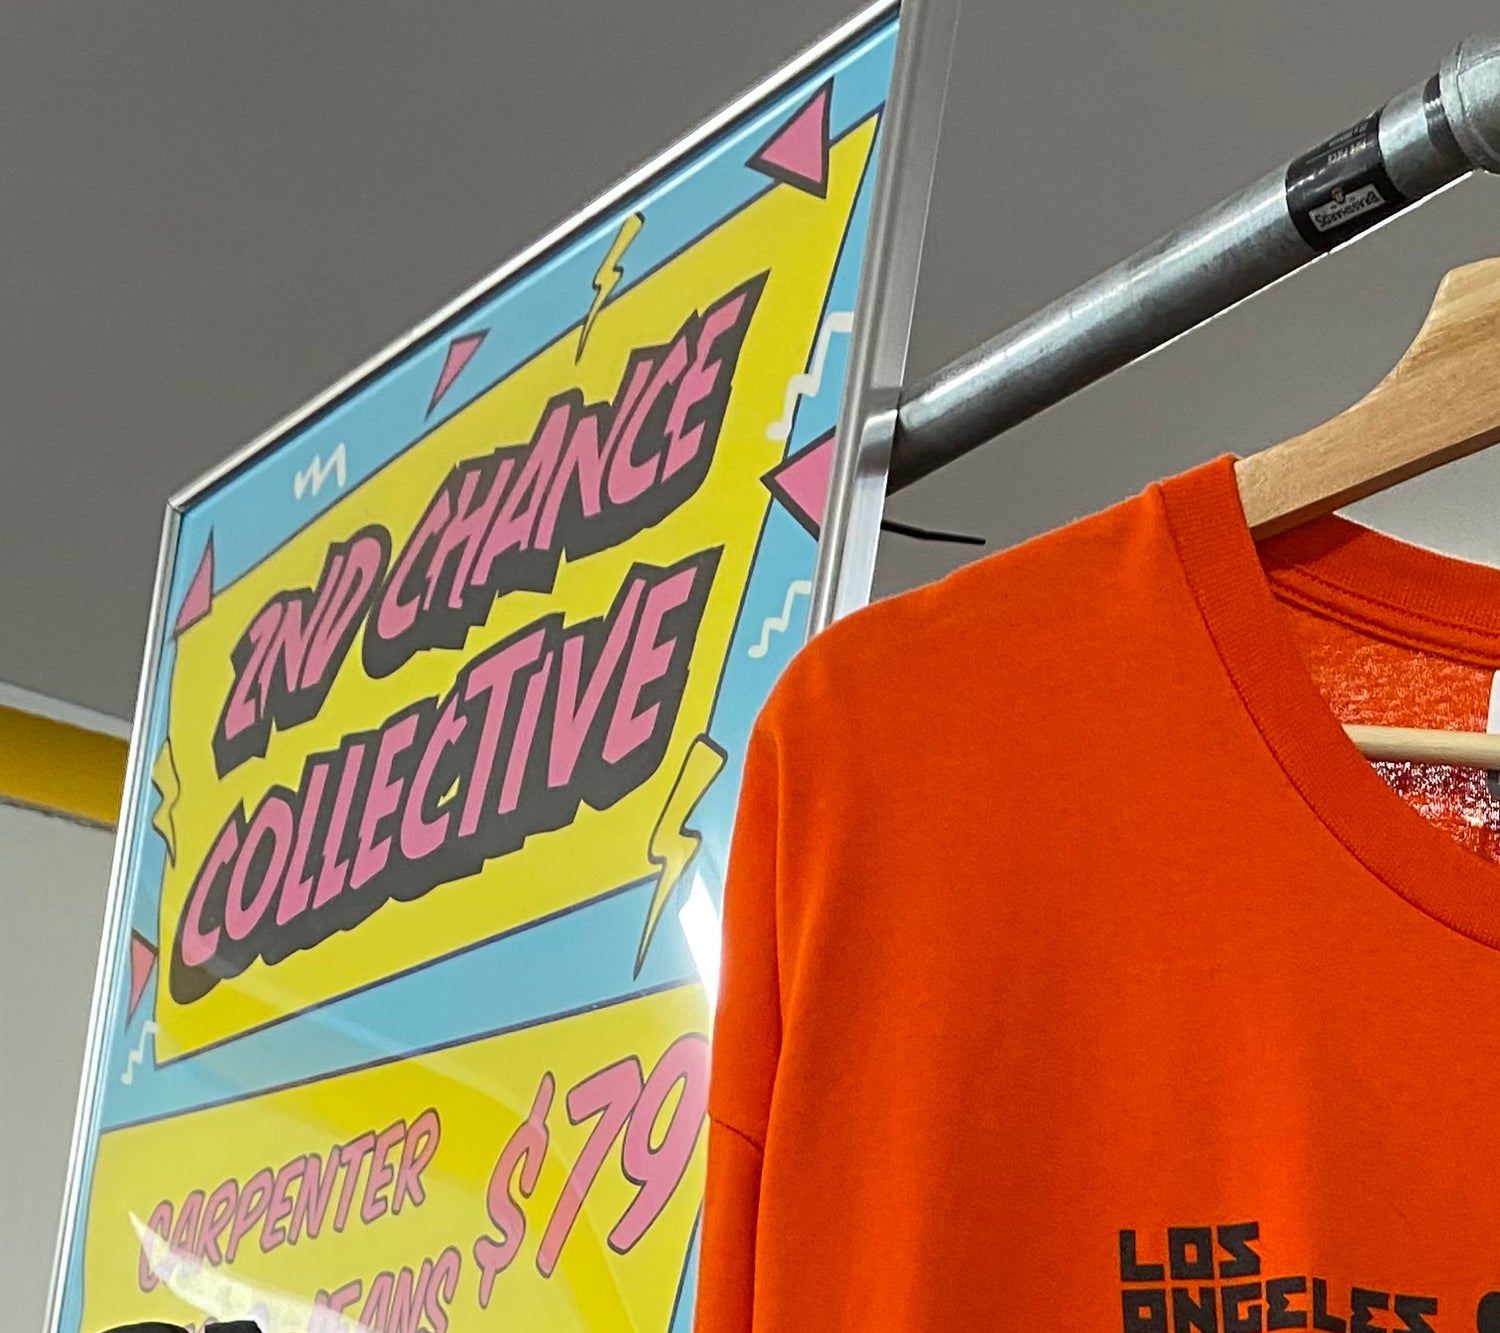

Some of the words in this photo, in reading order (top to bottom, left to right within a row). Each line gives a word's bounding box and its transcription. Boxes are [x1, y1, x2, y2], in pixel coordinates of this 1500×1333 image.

[221, 534, 387, 748] 2ND
[372, 287, 752, 648] CHANCE
[178, 562, 706, 972] COLLECTIVE
[138, 1109, 442, 1295] CARPENTER
[473, 1032, 712, 1309] $79
[1119, 1221, 1261, 1282] LOS
